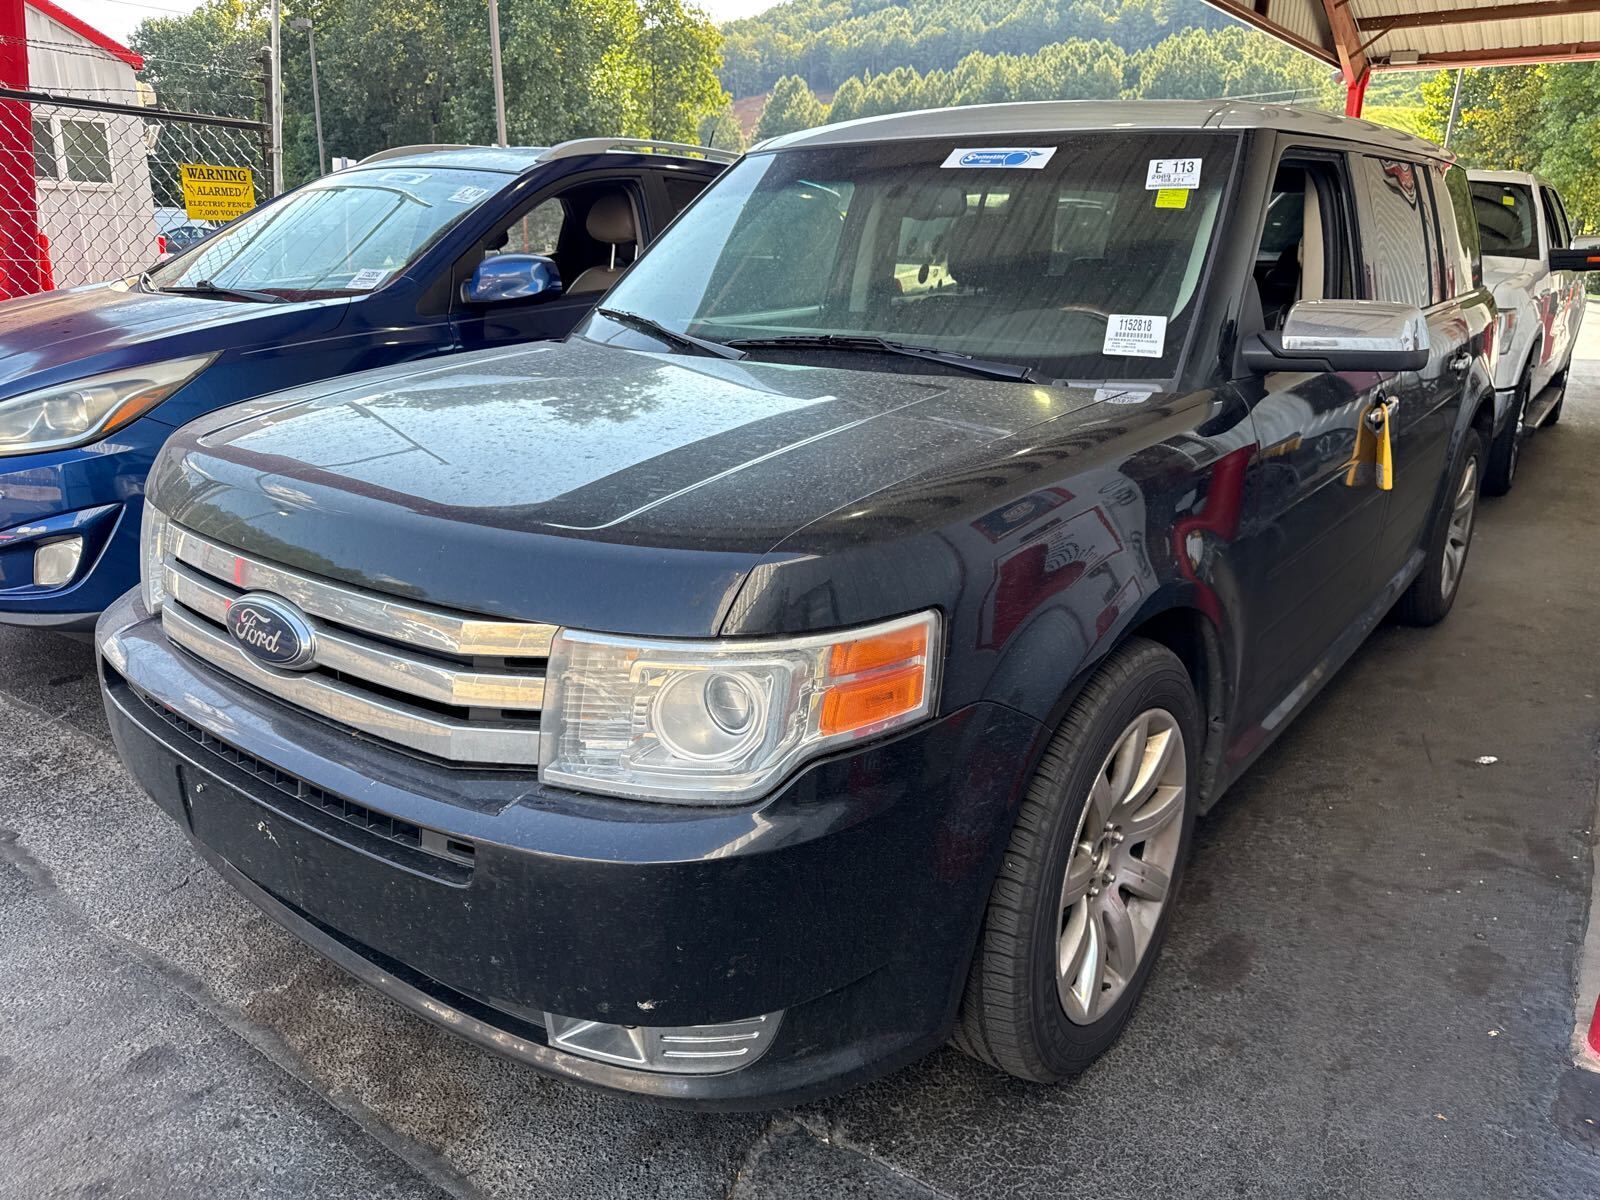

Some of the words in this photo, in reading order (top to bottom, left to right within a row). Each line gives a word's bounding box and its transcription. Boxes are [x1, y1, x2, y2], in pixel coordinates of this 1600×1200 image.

[1155, 162, 1163, 173] E
[1172, 161, 1195, 173] 113
[186, 167, 247, 181] WARNING
[196, 186, 242, 197] ALARMED
[188, 200, 226, 208] ELECTRIC
[227, 201, 252, 209] FENCE
[199, 209, 219, 217] 7,000
[1119, 318, 1152, 331] 1152818
[235, 608, 282, 653] Ford
